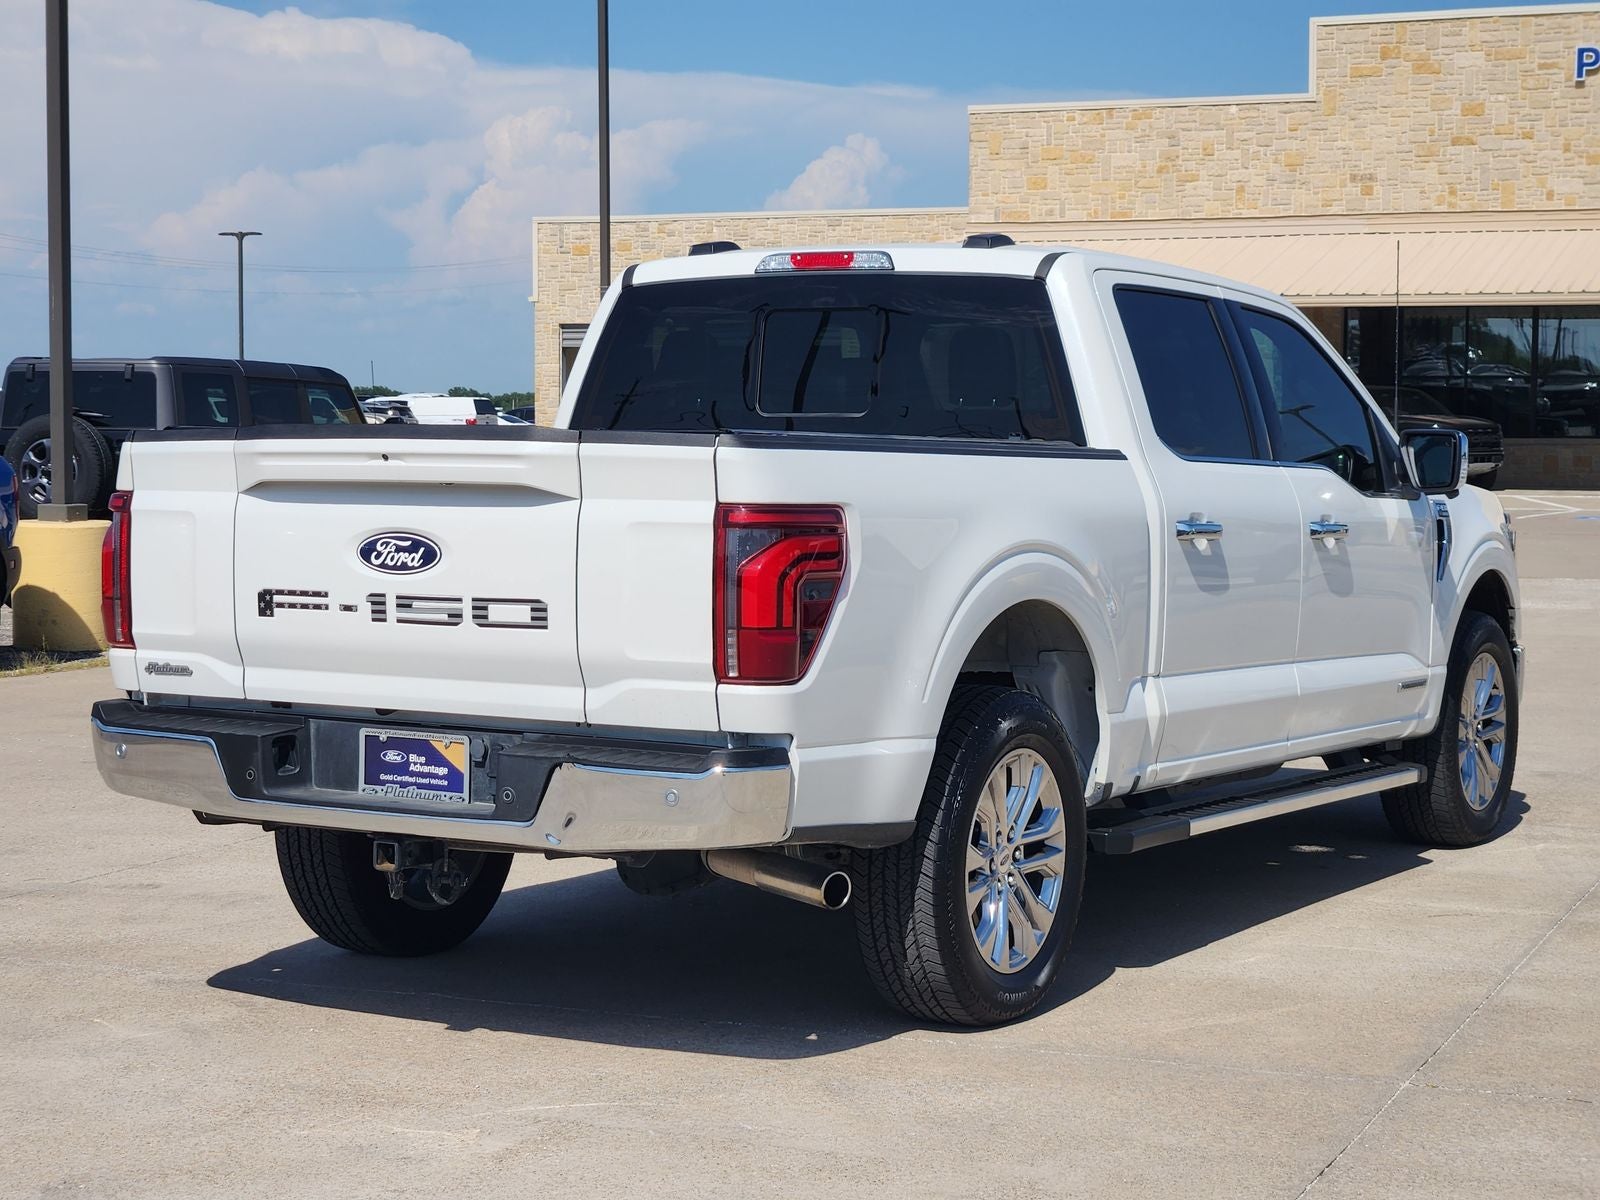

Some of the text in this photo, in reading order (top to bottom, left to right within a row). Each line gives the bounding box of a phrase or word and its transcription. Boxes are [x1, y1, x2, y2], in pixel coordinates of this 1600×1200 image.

[371, 537, 423, 567] Ford
[257, 588, 549, 629] F-150
[144, 661, 193, 677] Platinum
[385, 752, 403, 761] Ford
[408, 753, 426, 763] Blue
[409, 763, 448, 775] Advantage
[380, 773, 448, 786] Gold Certified Used Vehicle
[385, 785, 442, 801] Platinum
